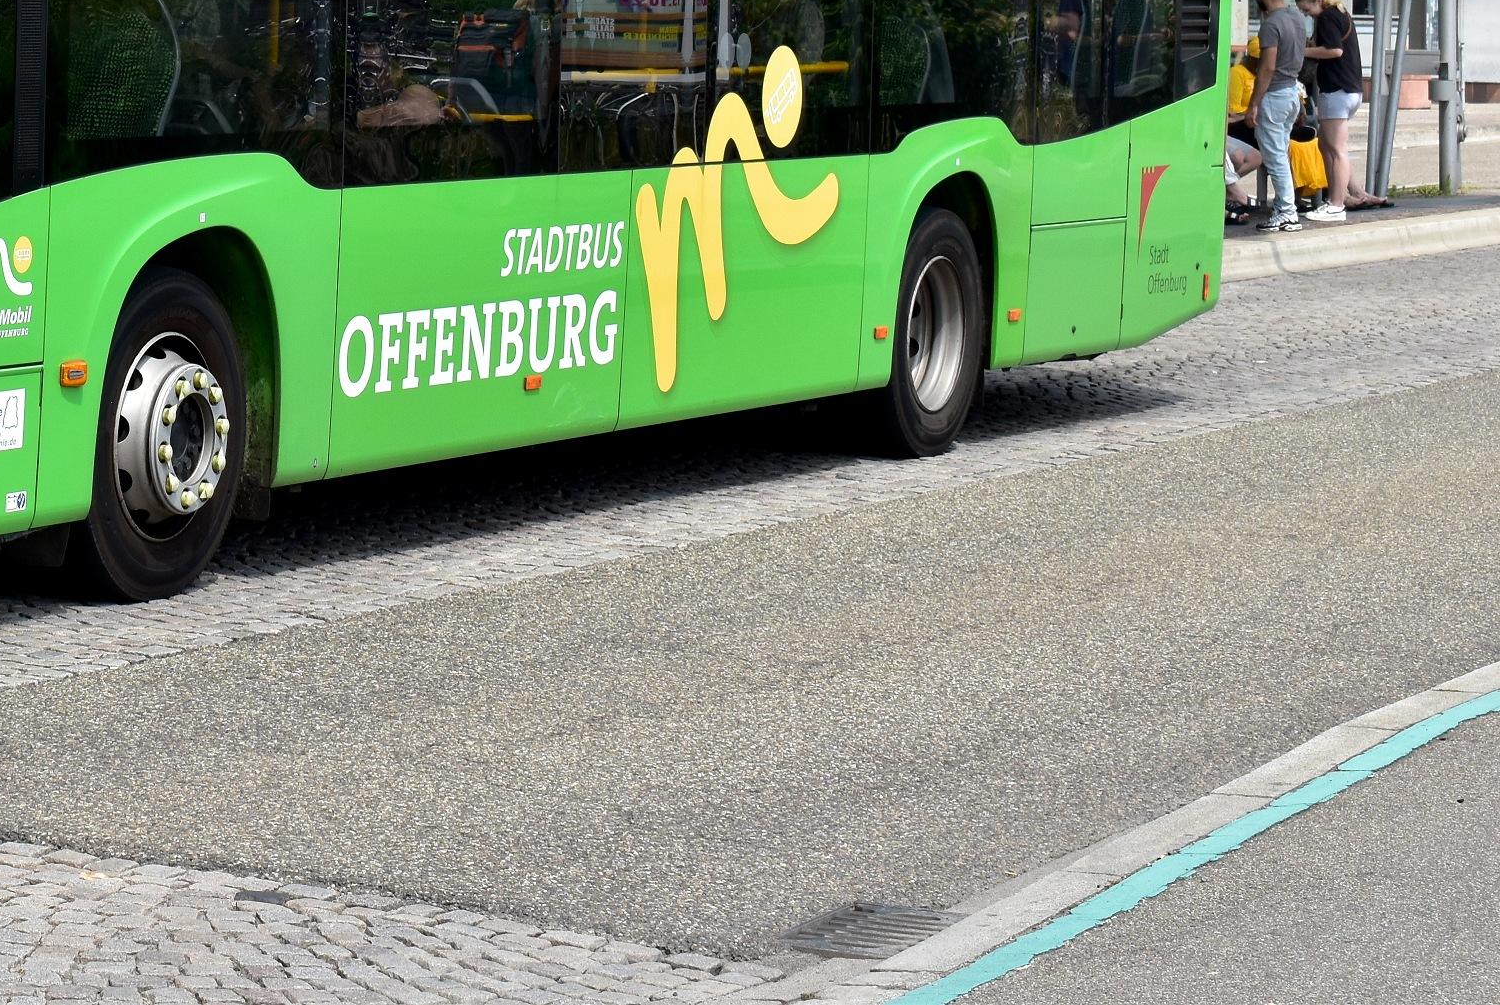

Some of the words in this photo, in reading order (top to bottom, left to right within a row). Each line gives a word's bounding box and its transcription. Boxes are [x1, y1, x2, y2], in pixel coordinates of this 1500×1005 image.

[500, 219, 626, 278] STADTBUS
[1149, 243, 1170, 266] Stadt
[1147, 271, 1188, 296] Offenburg
[338, 288, 619, 398] OFFENBURG
